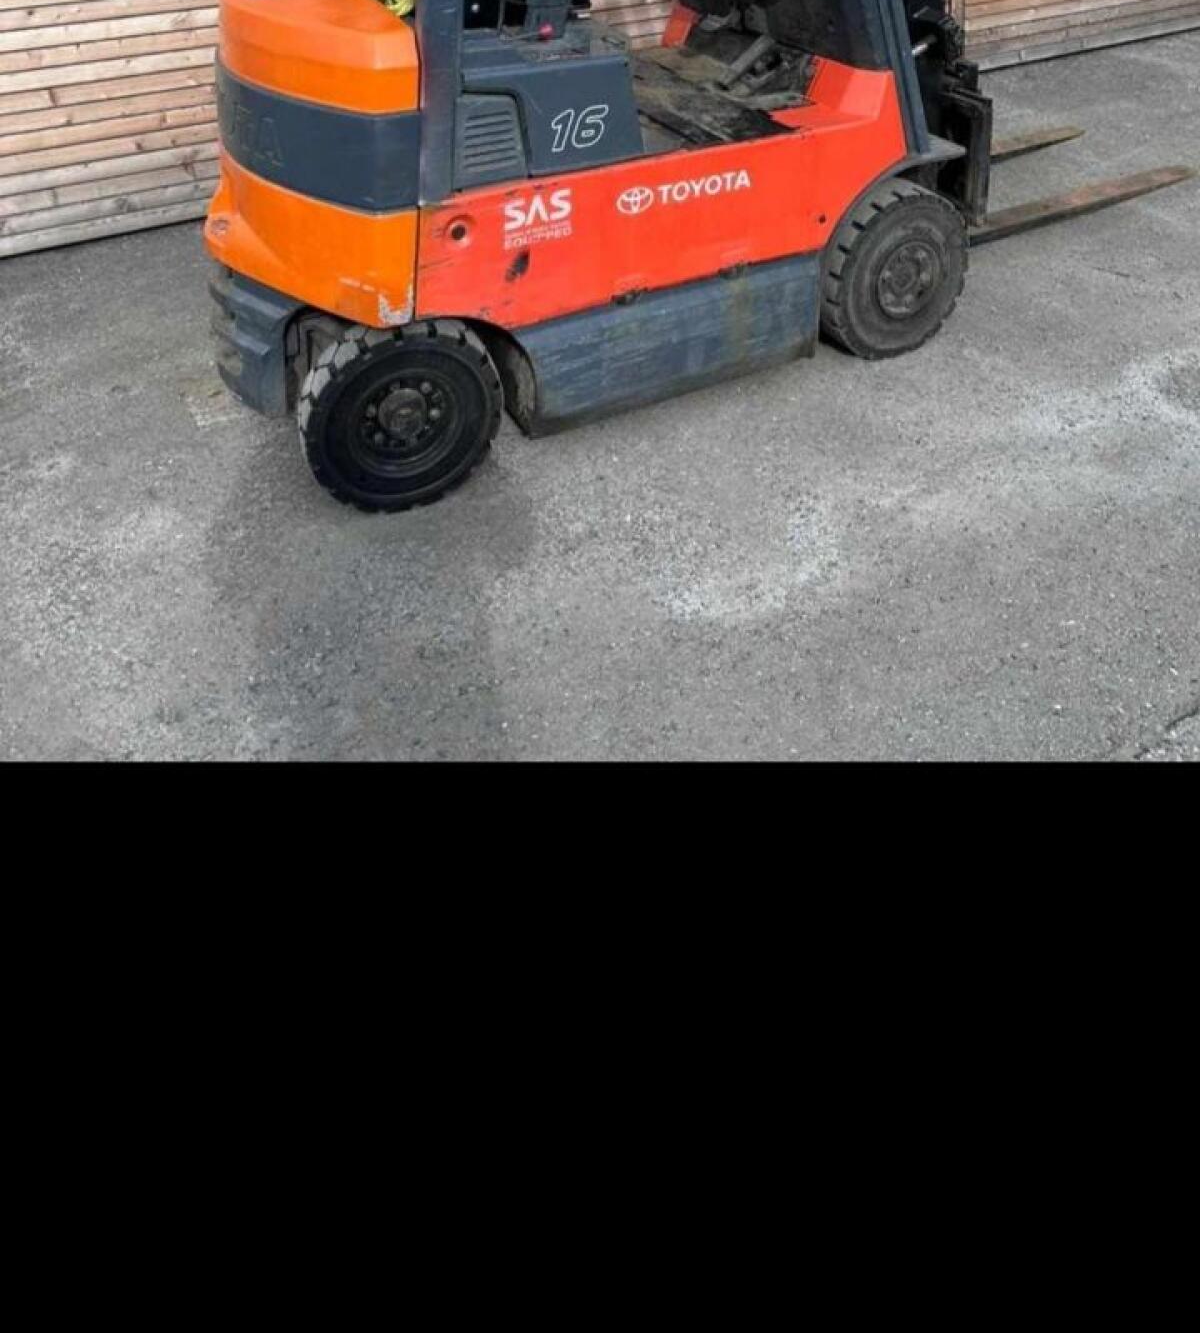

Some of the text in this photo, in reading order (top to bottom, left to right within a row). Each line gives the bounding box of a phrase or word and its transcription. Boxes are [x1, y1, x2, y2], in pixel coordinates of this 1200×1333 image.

[551, 104, 609, 152] 16
[658, 169, 751, 204] TOYOTA
[504, 188, 572, 231] SAS
